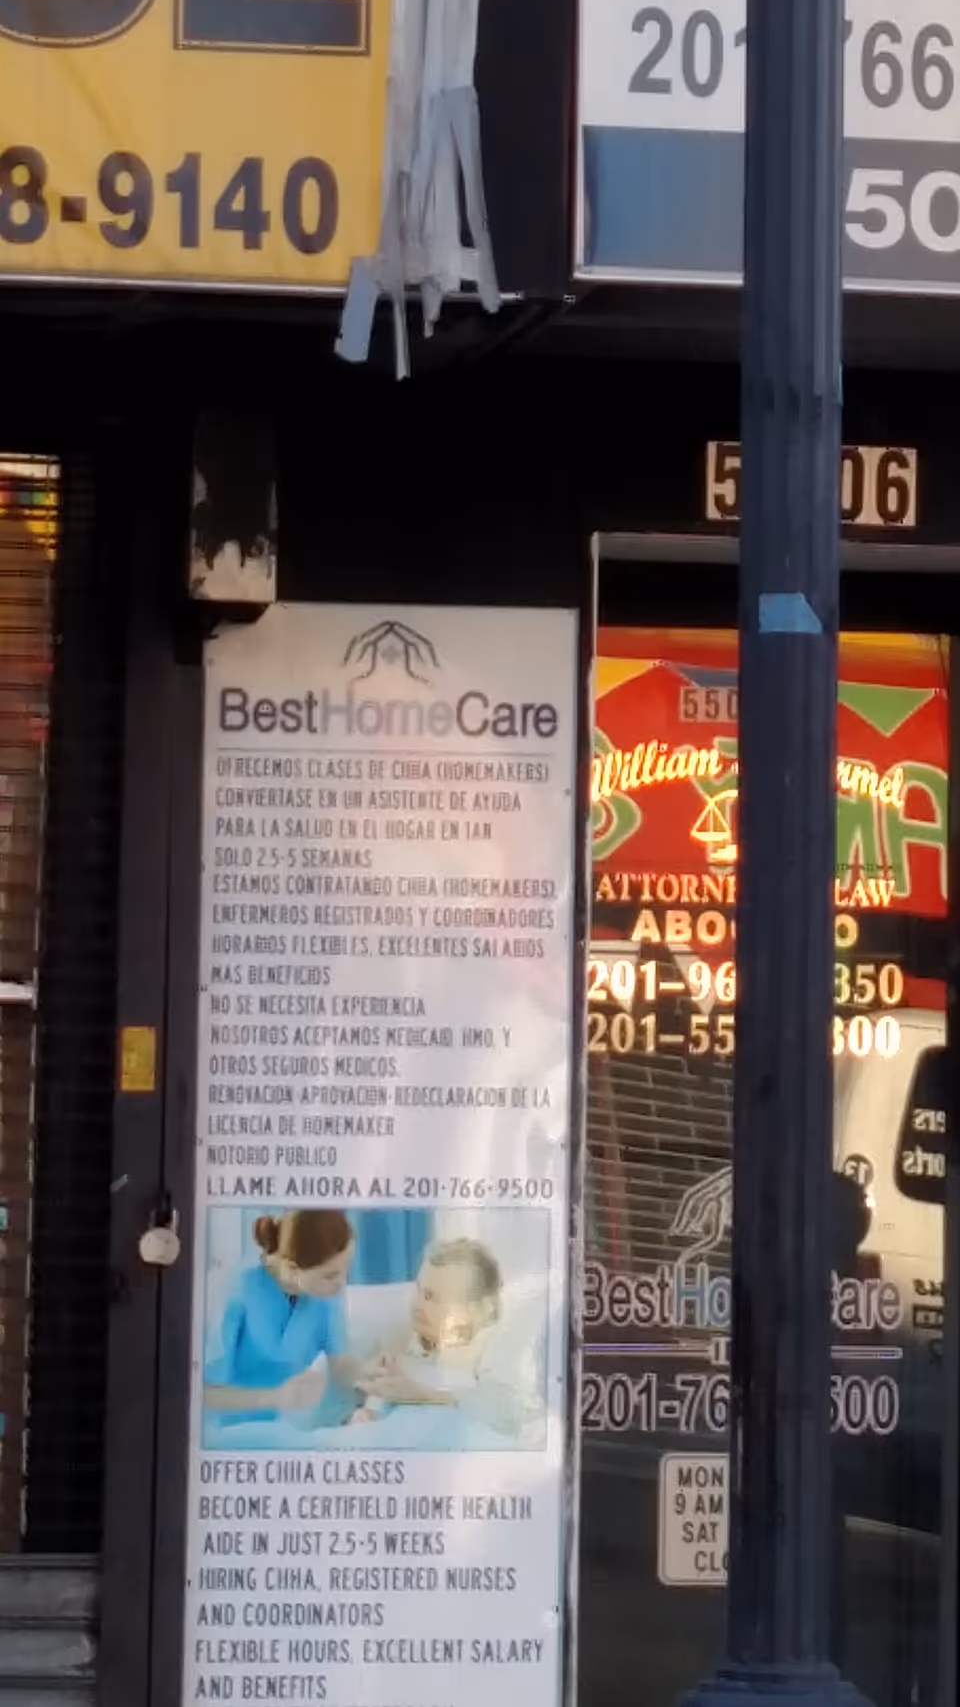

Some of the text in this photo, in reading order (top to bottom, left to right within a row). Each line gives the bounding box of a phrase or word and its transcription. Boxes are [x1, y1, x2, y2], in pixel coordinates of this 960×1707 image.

[713, 444, 911, 525] 506
[219, 688, 558, 738] BestHomeCare
[682, 689, 738, 721] 550
[216, 756, 301, 778] OFRECEMOS
[308, 757, 362, 779] CLASES
[369, 759, 384, 780] DE
[591, 740, 722, 801] William
[215, 787, 313, 808] CONVIERTASE
[318, 787, 337, 808] EN
[369, 789, 443, 811] ASISTENTE
[449, 790, 467, 811] DE
[473, 791, 522, 812] AYUDA
[215, 817, 255, 837] PARA
[261, 818, 279, 837] LA
[285, 818, 333, 838] SALUD
[339, 819, 357, 839] EN
[441, 820, 460, 840] EN
[214, 847, 252, 868] SOLO
[301, 848, 372, 868] SEMANAS
[213, 875, 280, 894] ESTAMOS
[285, 876, 392, 895] CONTRATANDO
[212, 904, 555, 929] ENFERMEROS REGISTRADOS Y COORDINADORES
[630, 909, 859, 948] ABOO
[212, 936, 287, 955] HORARIOS
[379, 937, 468, 957] EXCELENTES
[473, 938, 545, 958] SALARIOS
[211, 965, 331, 986] MAS BENEFICIOS
[210, 995, 425, 1017] NO SE NECESITA EXPERIENCIA
[210, 1025, 288, 1046] NOSOTROS
[293, 1026, 380, 1047] ACEPTAMOS
[210, 1055, 257, 1076] OTROS
[262, 1056, 329, 1076] SEGUROS
[208, 1115, 395, 1137] LICENCIA DE HOMEMAKER
[275, 1146, 337, 1166] PUBLICO
[207, 1175, 276, 1195] LLAME
[287, 1176, 360, 1196] AHORA
[370, 1177, 396, 1196] AL
[580, 1262, 900, 1329] BestHoare
[200, 1460, 258, 1484] OFFER
[322, 1460, 405, 1485] CLASSES
[199, 1496, 533, 1521] BECOME A CERTIFIELD HOME HEALTH
[674, 1493, 723, 1515] 9 AM
[203, 1531, 245, 1556] AIDE
[251, 1531, 269, 1555] IN
[276, 1531, 322, 1556] JUST
[384, 1532, 446, 1557] WEEKS
[682, 1521, 718, 1543] SAT
[199, 1566, 257, 1592] HIRING
[329, 1567, 438, 1592] REGISTERED
[445, 1567, 518, 1592] NURSES
[196, 1602, 385, 1627] AND COORDINATORS
[195, 1639, 280, 1664] FLEXIBLE
[362, 1639, 464, 1665] EXCELLENT
[471, 1640, 544, 1665] SALARY
[194, 1675, 328, 1700] AND BENEFITS
